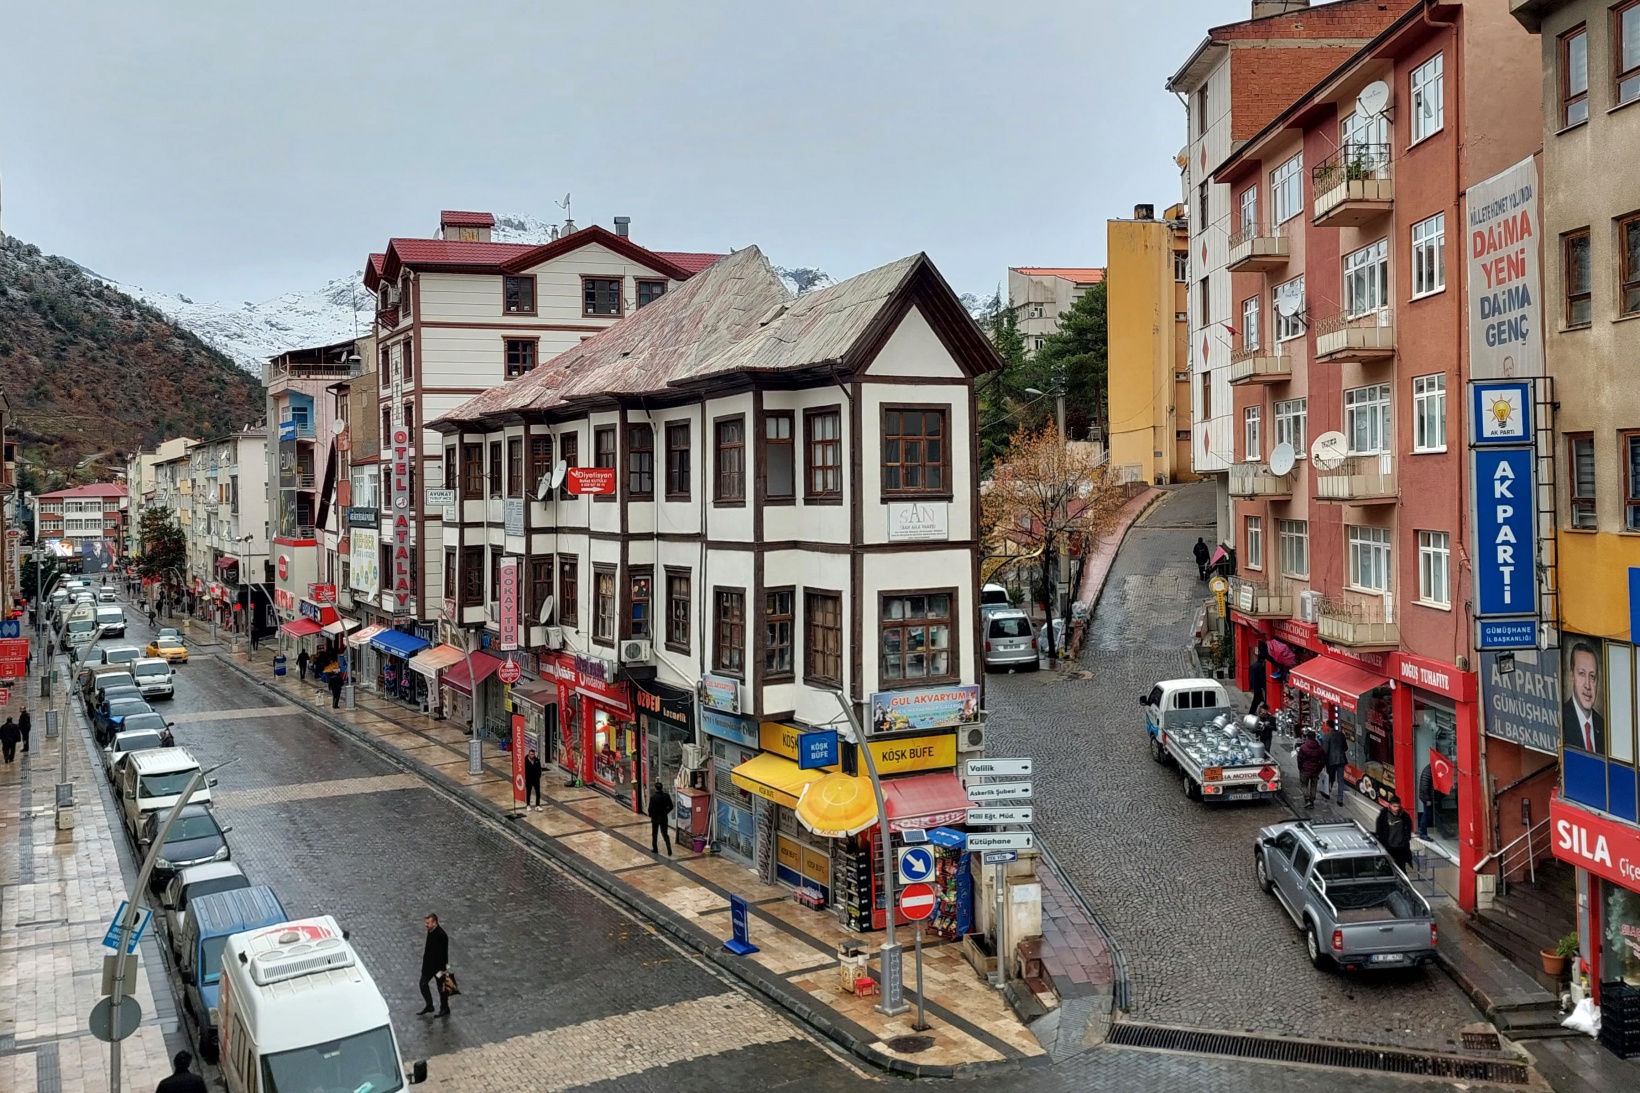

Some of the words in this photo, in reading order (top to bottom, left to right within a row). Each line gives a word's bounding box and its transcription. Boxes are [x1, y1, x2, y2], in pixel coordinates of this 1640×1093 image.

[1491, 197, 1508, 217] HİZMET
[1472, 210, 1532, 259] DAİMA
[1481, 248, 1526, 289] YENİ
[1480, 283, 1532, 320] DAİMA
[1486, 314, 1529, 347] GENÇ
[394, 430, 407, 491] OTEL
[578, 471, 612, 480] Diyetisyen
[1493, 460, 1515, 498] AK
[395, 515, 409, 606] ATALAY
[1495, 505, 1517, 604] PARTİ
[503, 568, 514, 613] GÖKAY
[504, 617, 514, 642] TUR
[1486, 626, 1532, 634] GÜMÜŞHANE
[914, 692, 967, 704] AKVARYUM
[1313, 685, 1341, 703] LOKMAN
[811, 742, 828, 753] KÖŞK
[811, 752, 828, 760] BÜFE
[882, 748, 907, 763] KÖŞK
[909, 745, 934, 759] BÜFE
[996, 788, 1016, 796] Şubesi
[984, 813, 998, 821] Eğt.
[969, 837, 1012, 846] Kütüphane
[1556, 818, 1613, 868] SILA
